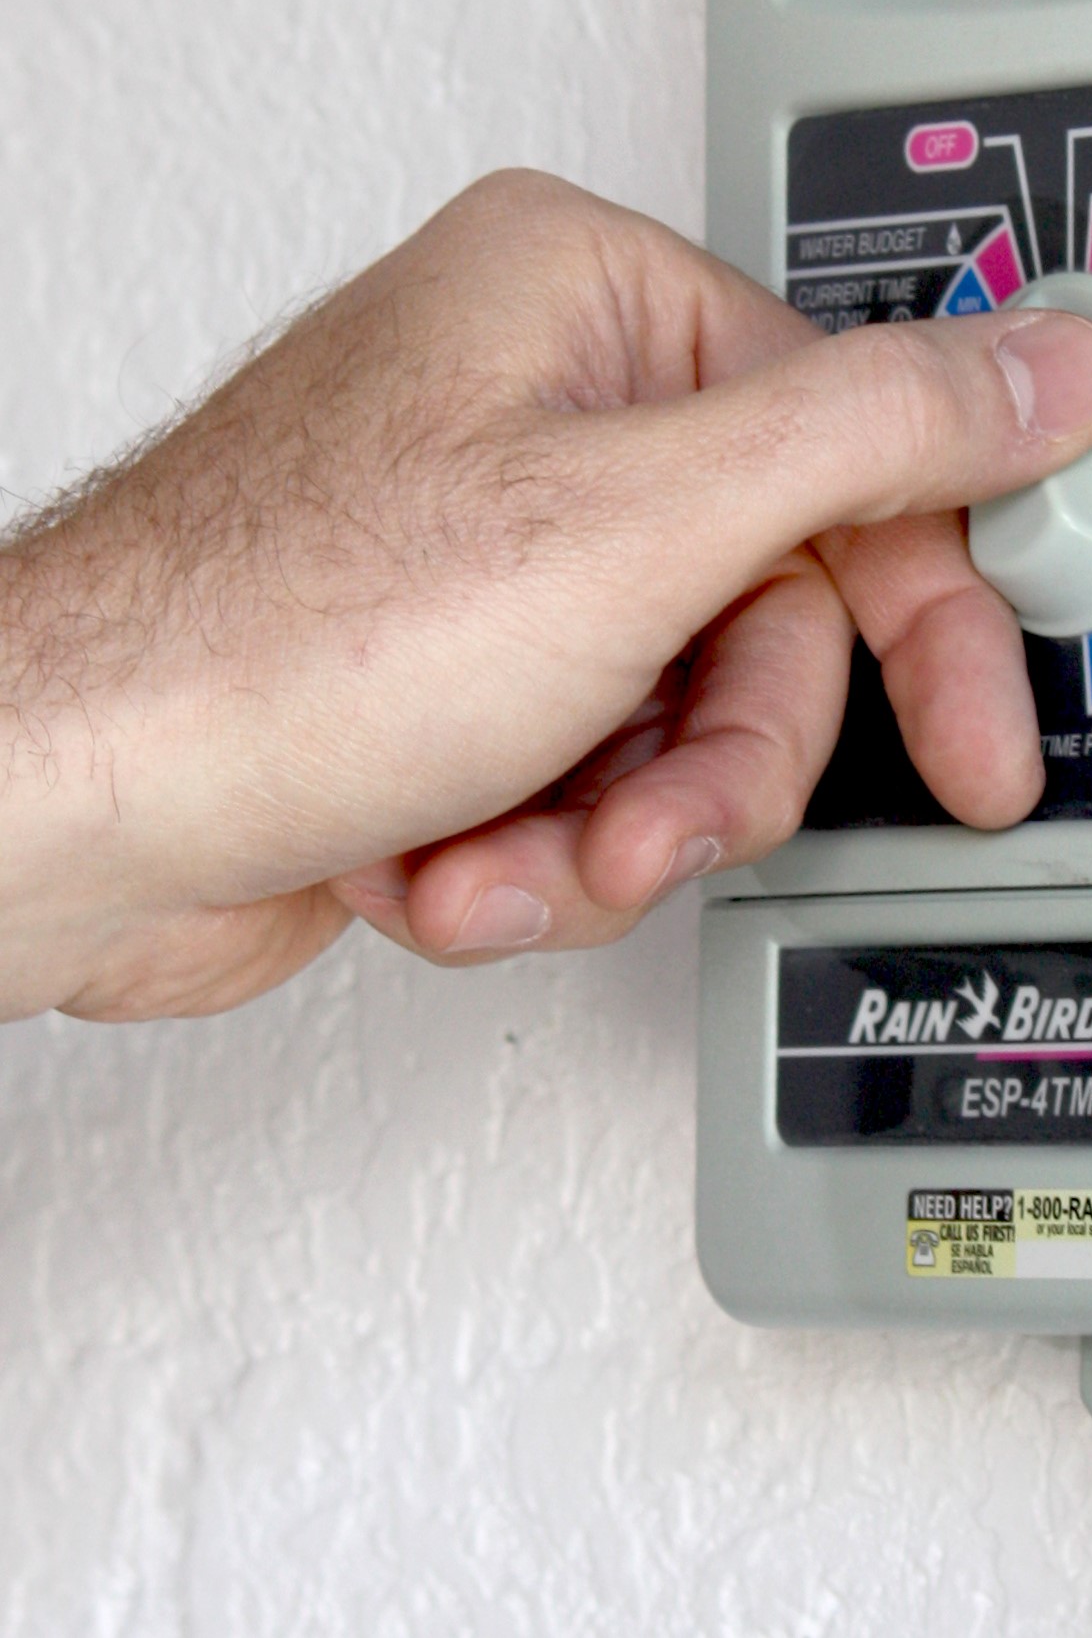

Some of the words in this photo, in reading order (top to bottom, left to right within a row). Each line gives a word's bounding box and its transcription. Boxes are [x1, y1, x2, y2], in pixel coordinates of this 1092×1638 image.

[925, 134, 957, 158] OFF
[800, 234, 854, 260] WATER
[858, 227, 927, 255] BUDGET
[795, 278, 876, 310] CURRENT
[879, 276, 917, 301] TIME
[1040, 733, 1082, 757] TIME
[848, 988, 958, 1044] RAIN
[914, 1194, 956, 1220] NEED
[960, 1194, 1013, 1220] HELP?
[940, 1224, 965, 1242] CALL
[965, 1224, 979, 1241] US
[983, 1224, 1015, 1243] FIRST!
[1067, 1222, 1086, 1236] local
[951, 1243, 962, 1257] SE
[964, 1243, 994, 1258] HABLA
